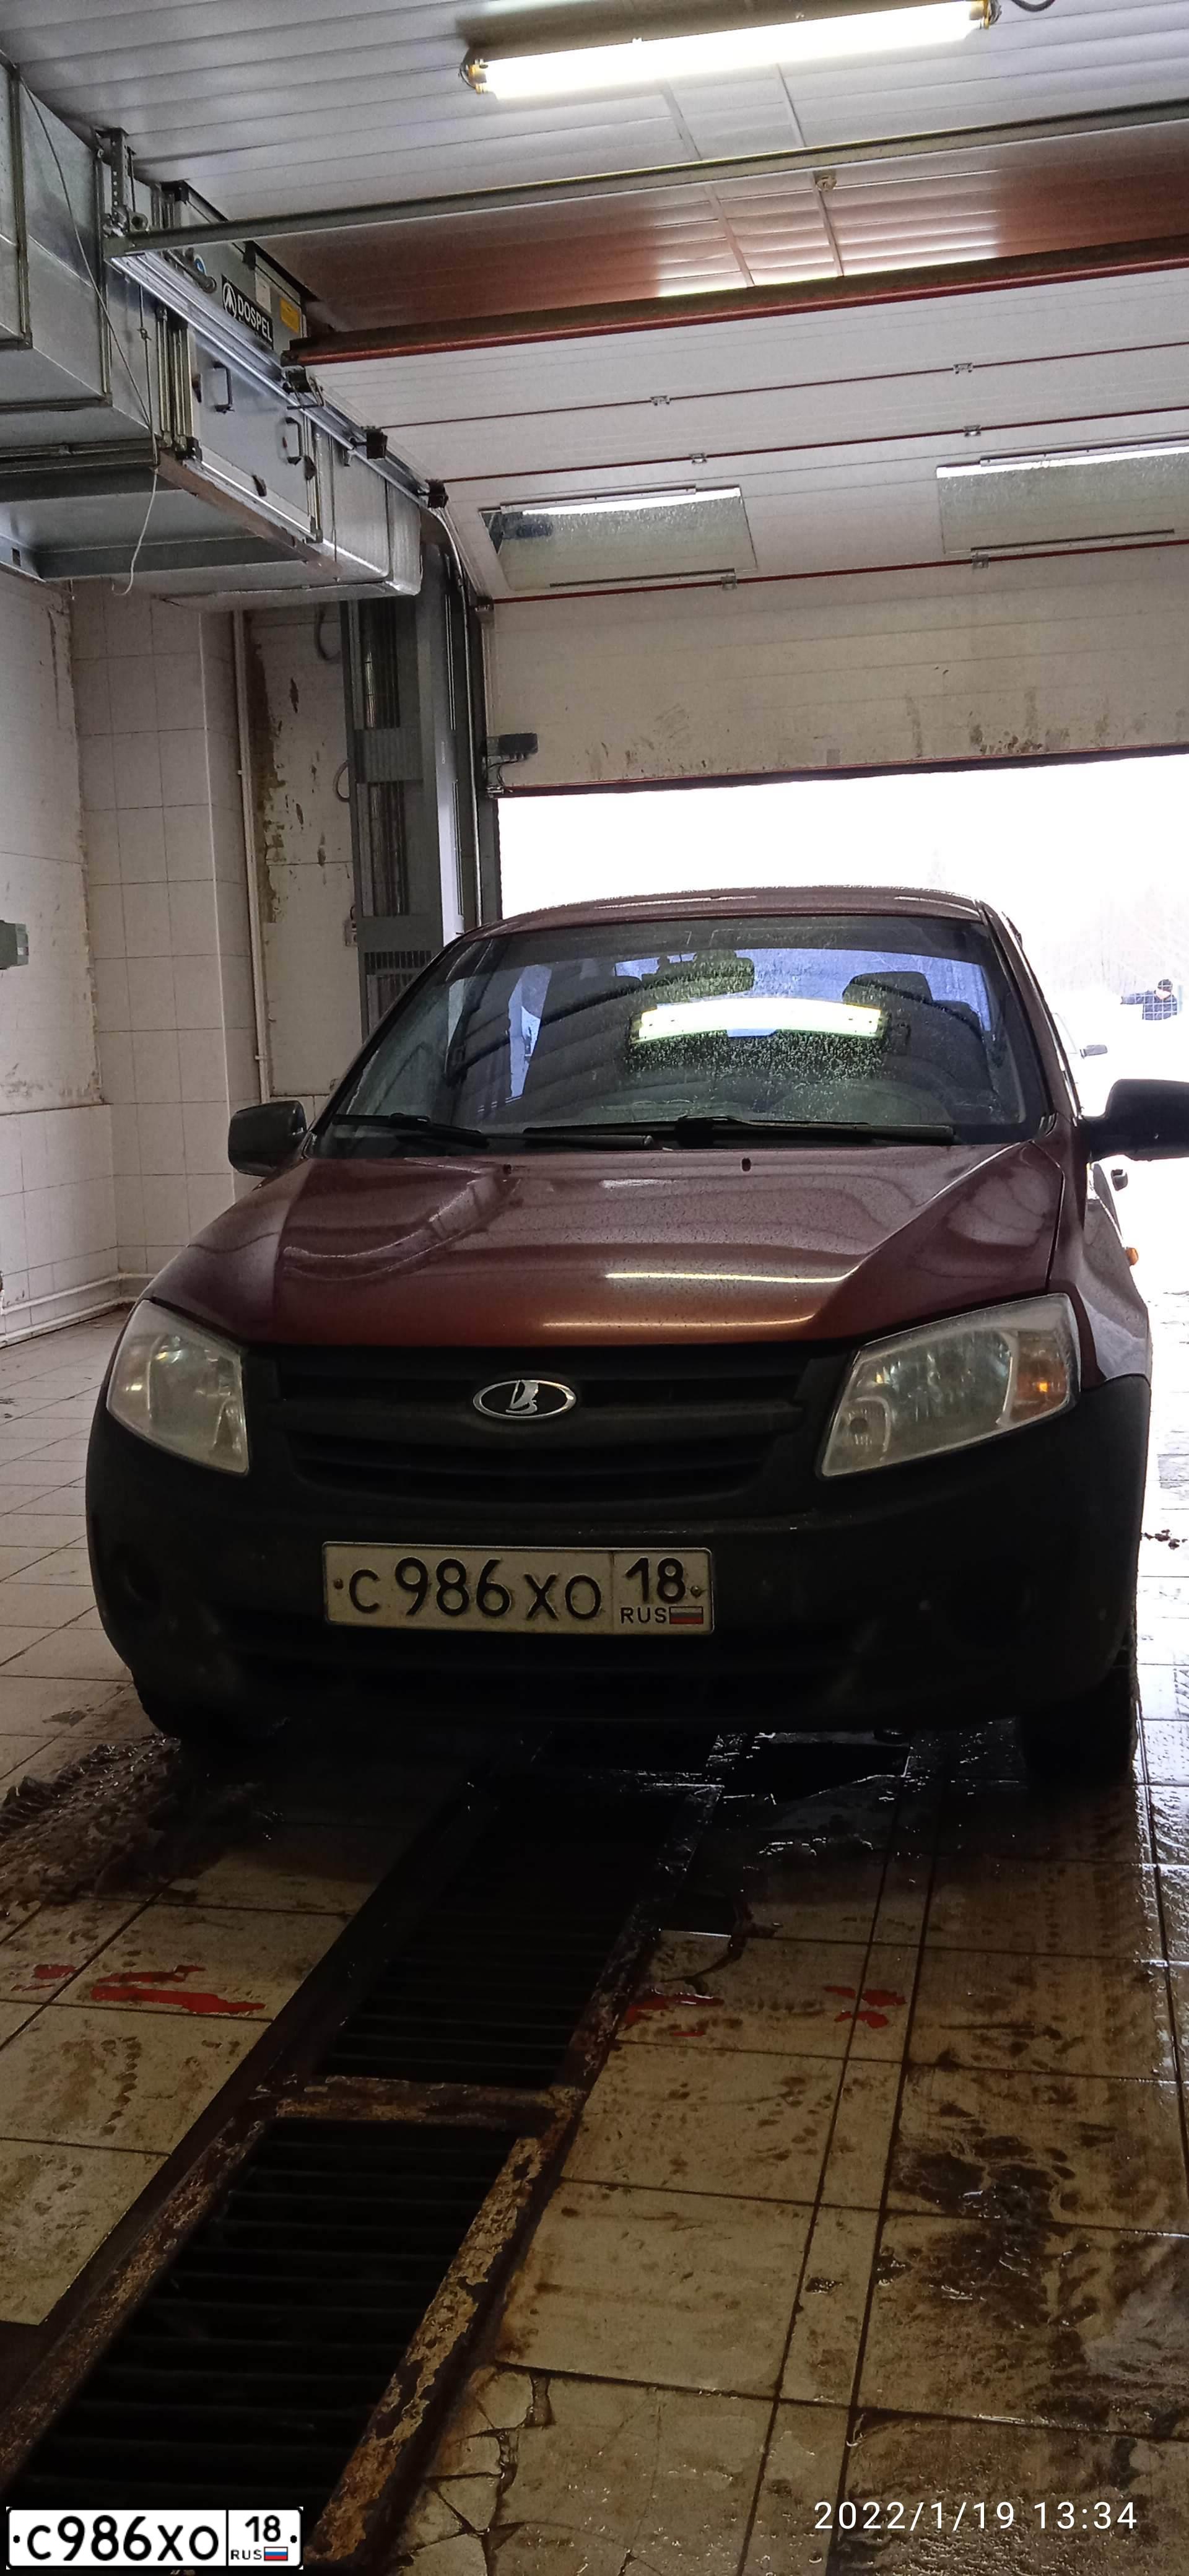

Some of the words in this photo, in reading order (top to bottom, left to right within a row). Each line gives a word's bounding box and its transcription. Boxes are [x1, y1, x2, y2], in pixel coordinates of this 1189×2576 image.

[237, 294, 272, 342] DOSPEL
[625, 1557, 686, 1604] 18
[621, 1606, 667, 1624] RUS
